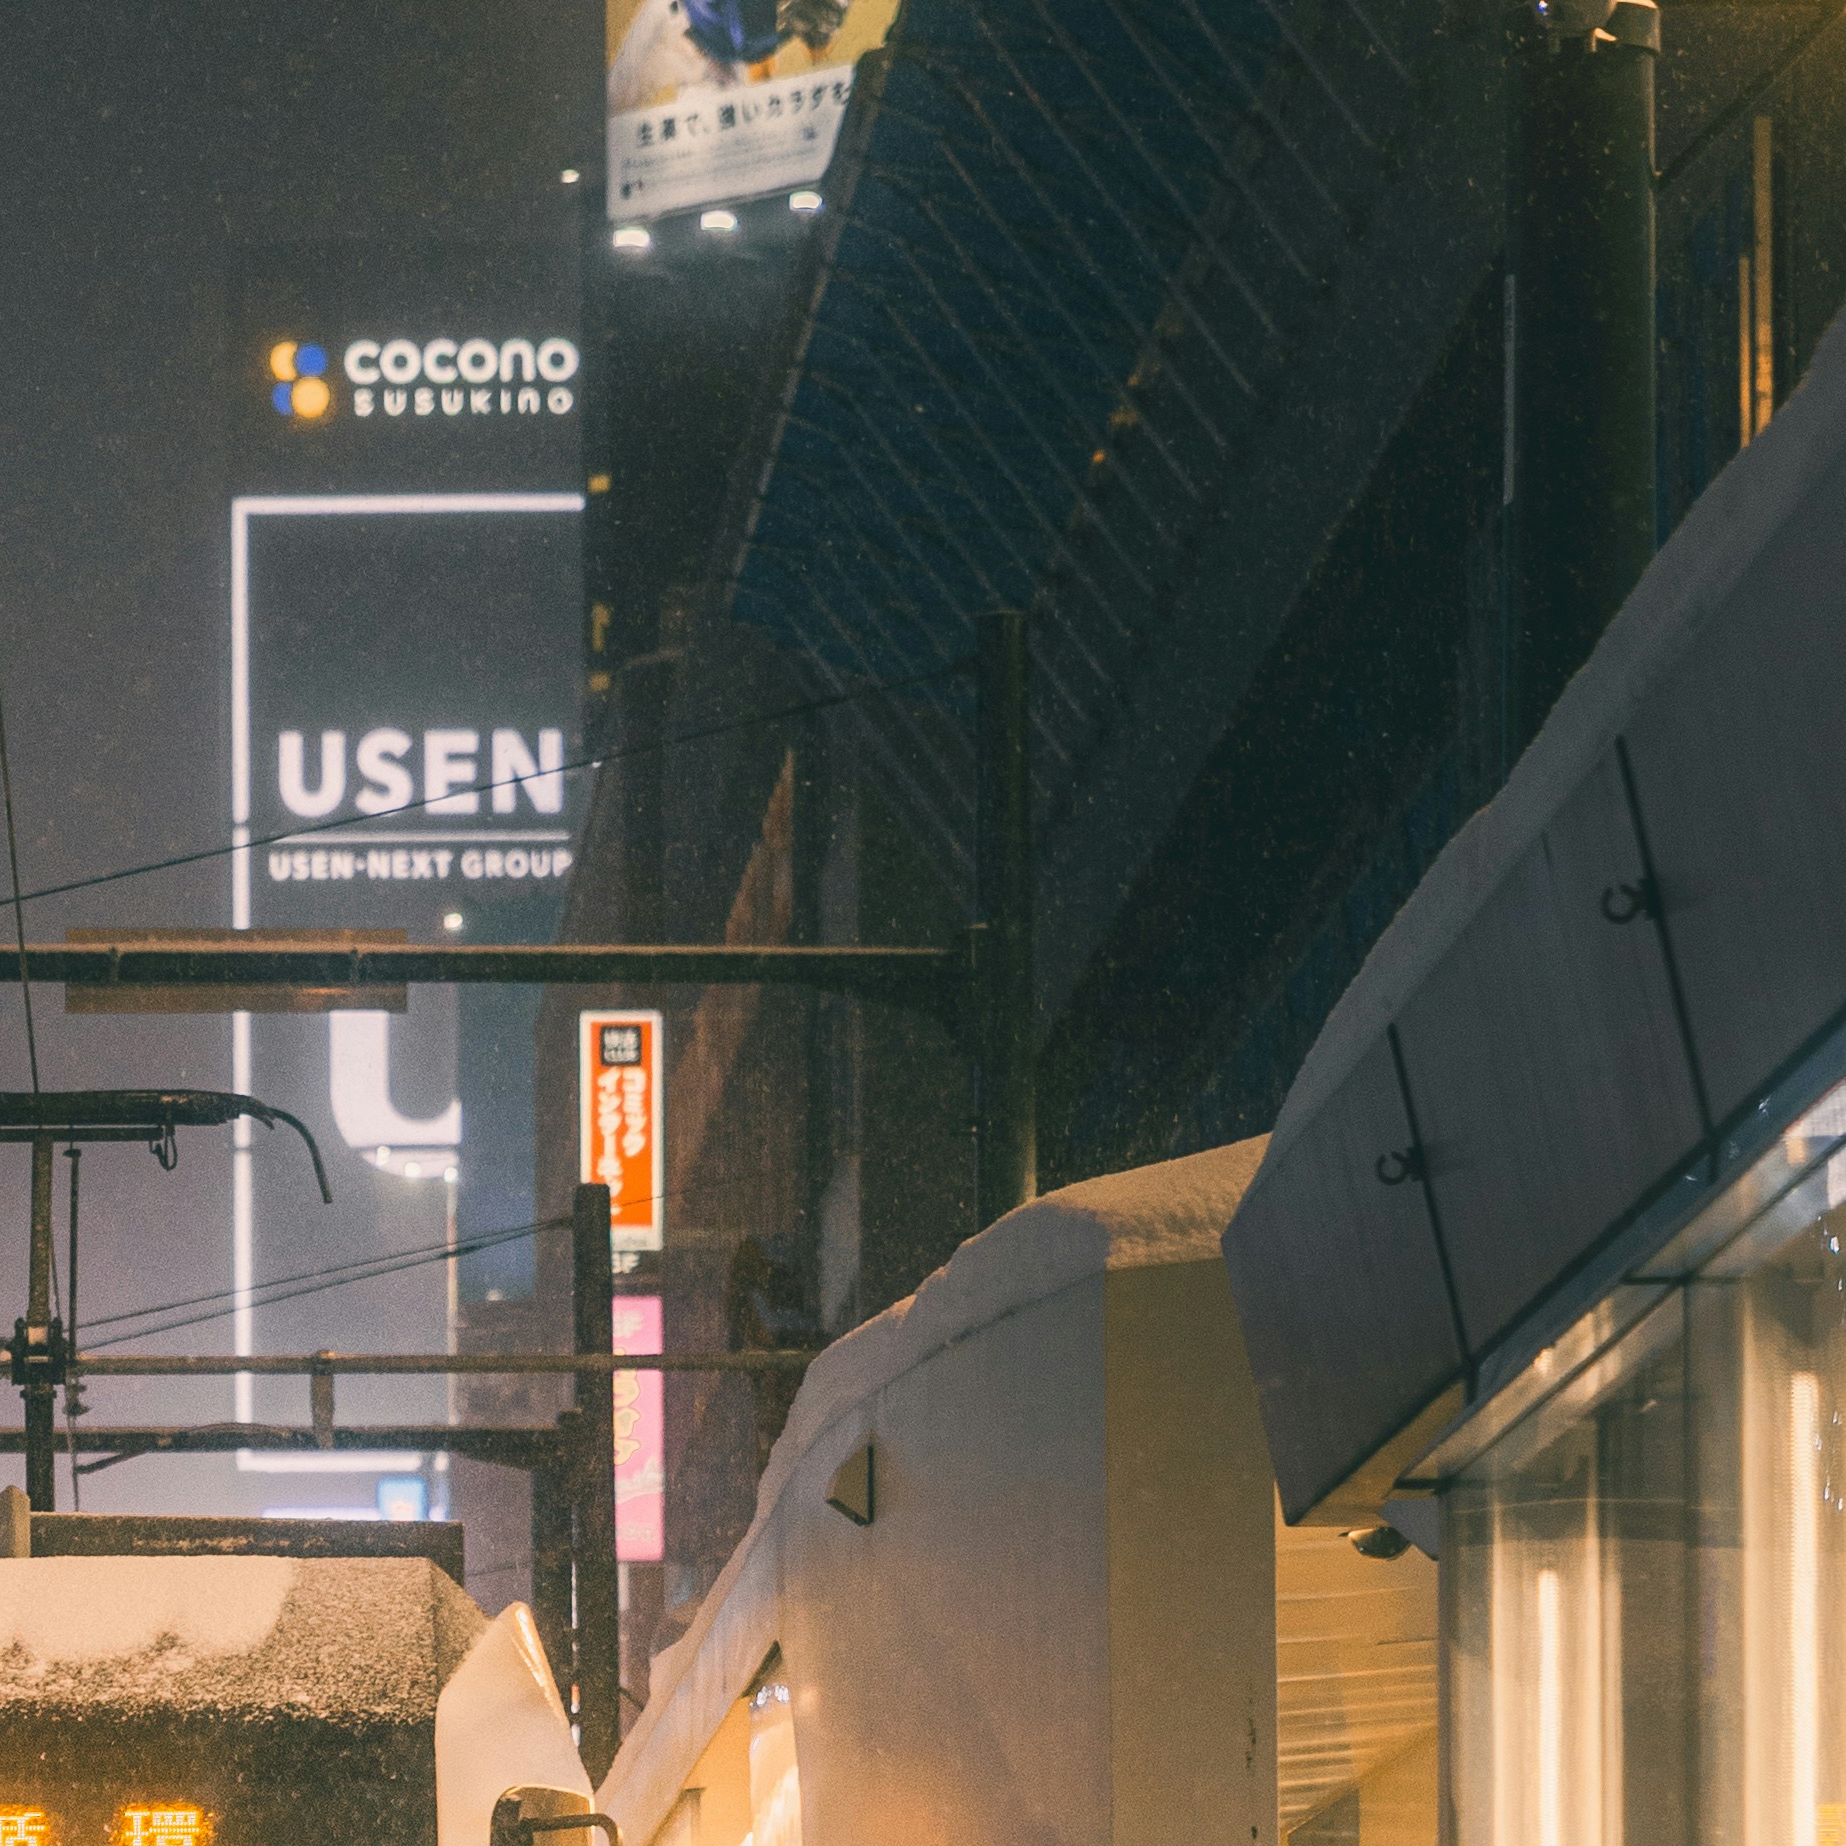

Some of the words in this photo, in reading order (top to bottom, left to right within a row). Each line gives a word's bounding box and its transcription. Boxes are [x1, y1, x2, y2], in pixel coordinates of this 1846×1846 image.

[354, 388, 574, 416] SUSUKINO
[278, 728, 563, 817] USEN
[269, 850, 453, 881] USEN-NEXT
[462, 850, 573, 880] GROUP
[622, 1067, 647, 1157] コミック
